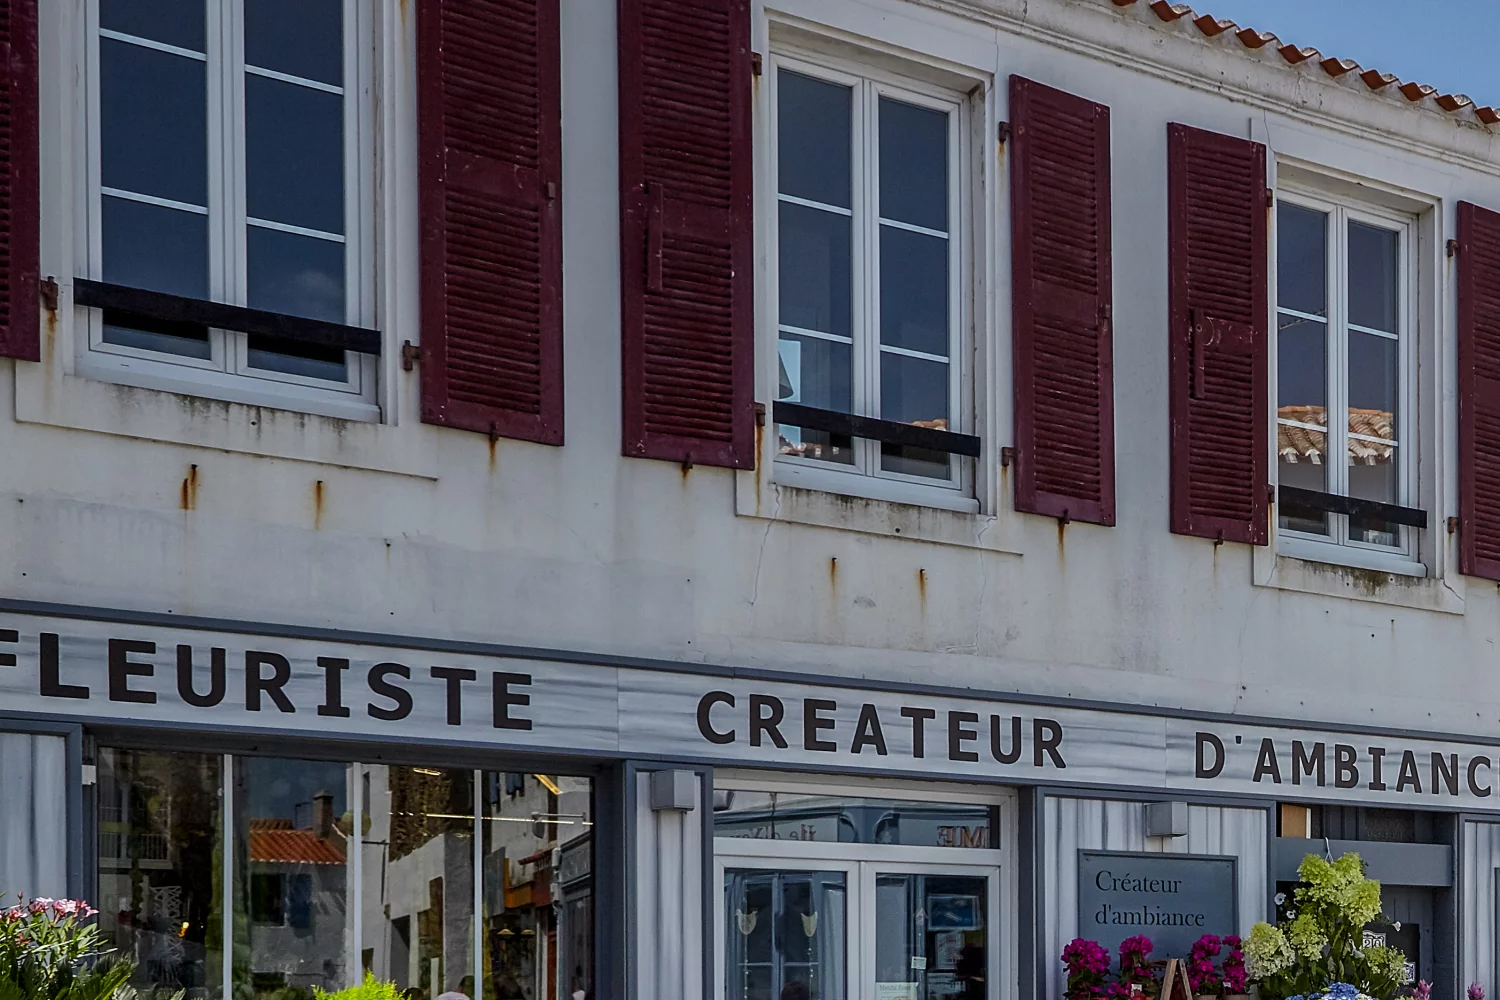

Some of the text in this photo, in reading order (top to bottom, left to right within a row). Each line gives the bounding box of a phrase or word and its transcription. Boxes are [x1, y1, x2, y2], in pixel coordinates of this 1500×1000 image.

[696, 690, 1067, 768] CREATEUR
[1095, 870, 1183, 895] Créateur
[1095, 904, 1205, 928] d'ambiance
